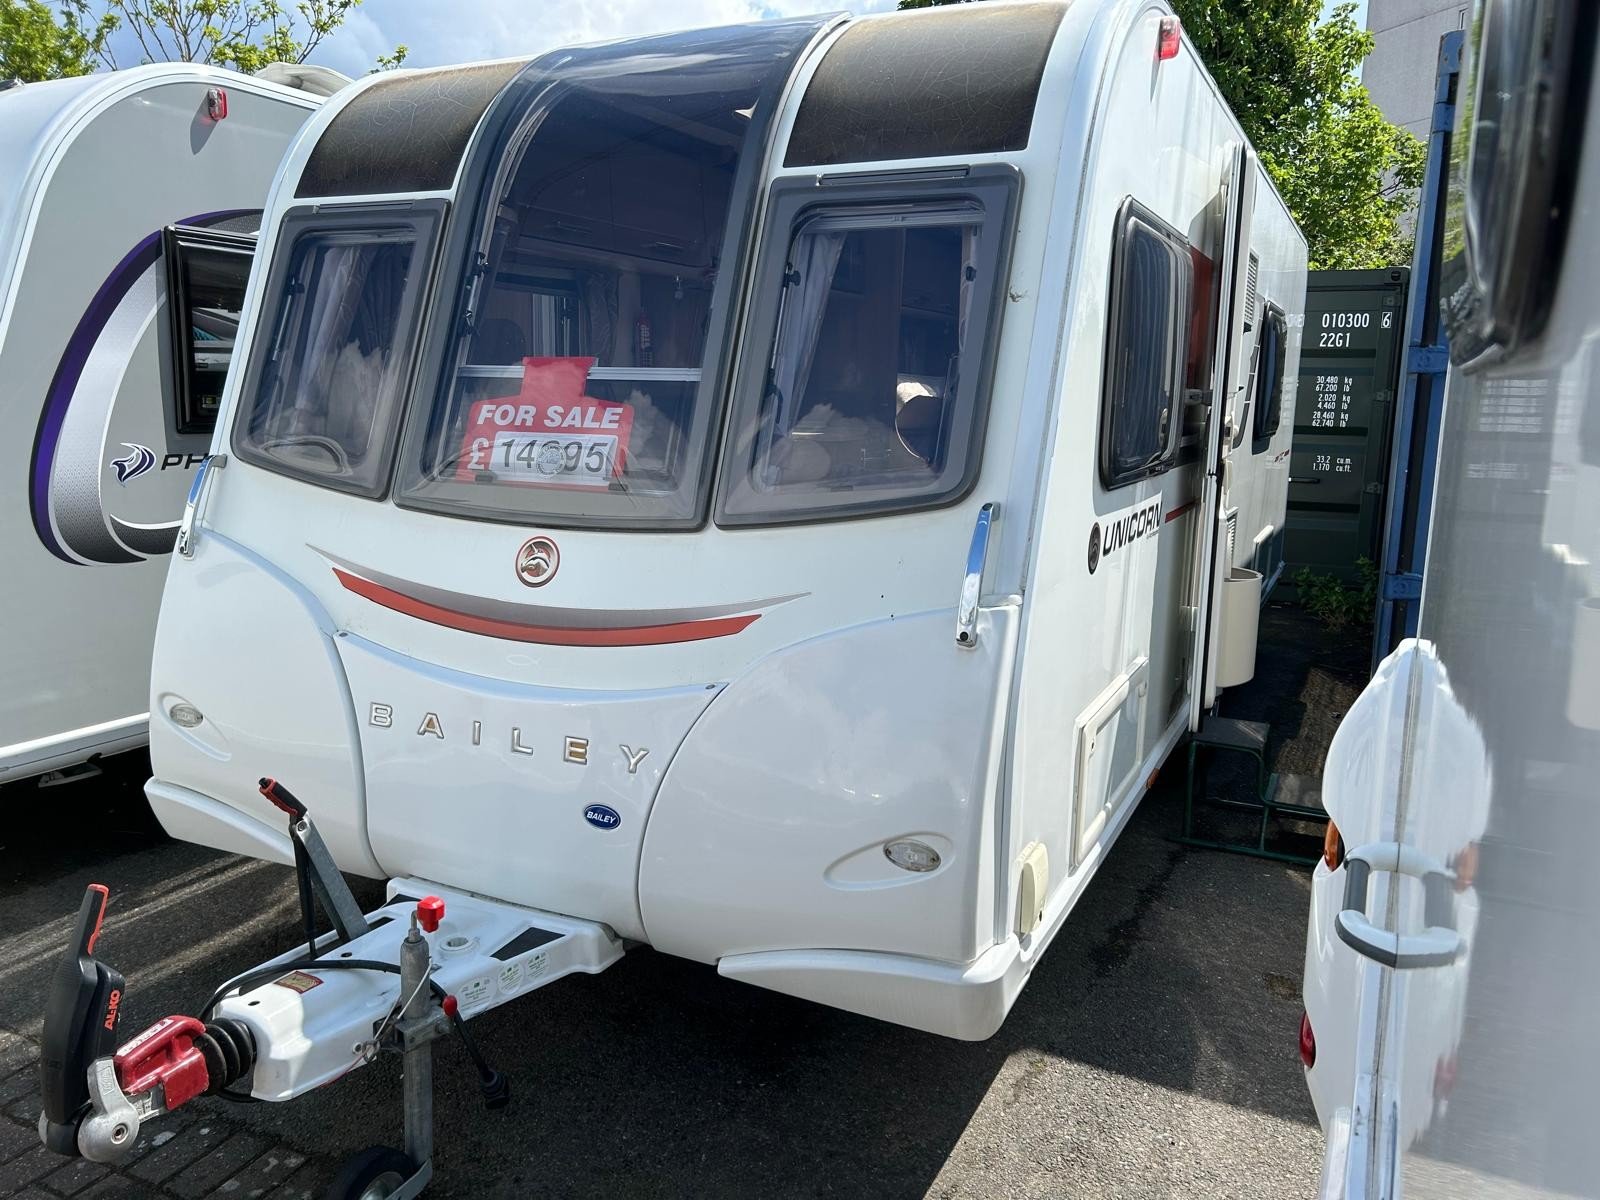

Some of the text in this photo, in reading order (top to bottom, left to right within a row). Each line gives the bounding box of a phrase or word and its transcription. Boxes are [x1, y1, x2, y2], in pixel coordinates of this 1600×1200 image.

[1321, 313, 1370, 328] 010300
[1381, 312, 1392, 328] 6
[1319, 332, 1351, 347] 22G1
[1316, 375, 1353, 386] 30.480 kg
[1315, 384, 1338, 392] 67.200
[1318, 393, 1351, 404] 2.020 kg
[1317, 402, 1348, 410] 4.460 lb
[477, 404, 624, 429] FOR SALE
[1312, 411, 1349, 422] 28.460 kg
[1312, 419, 1347, 428] 62.740 lb
[467, 437, 490, 470] £
[501, 439, 609, 474] 1495
[1102, 501, 1163, 558] UNICORN
[369, 701, 649, 774] BAILEY
[586, 811, 617, 824] BAILEY
[104, 989, 121, 1031] AL-KO
